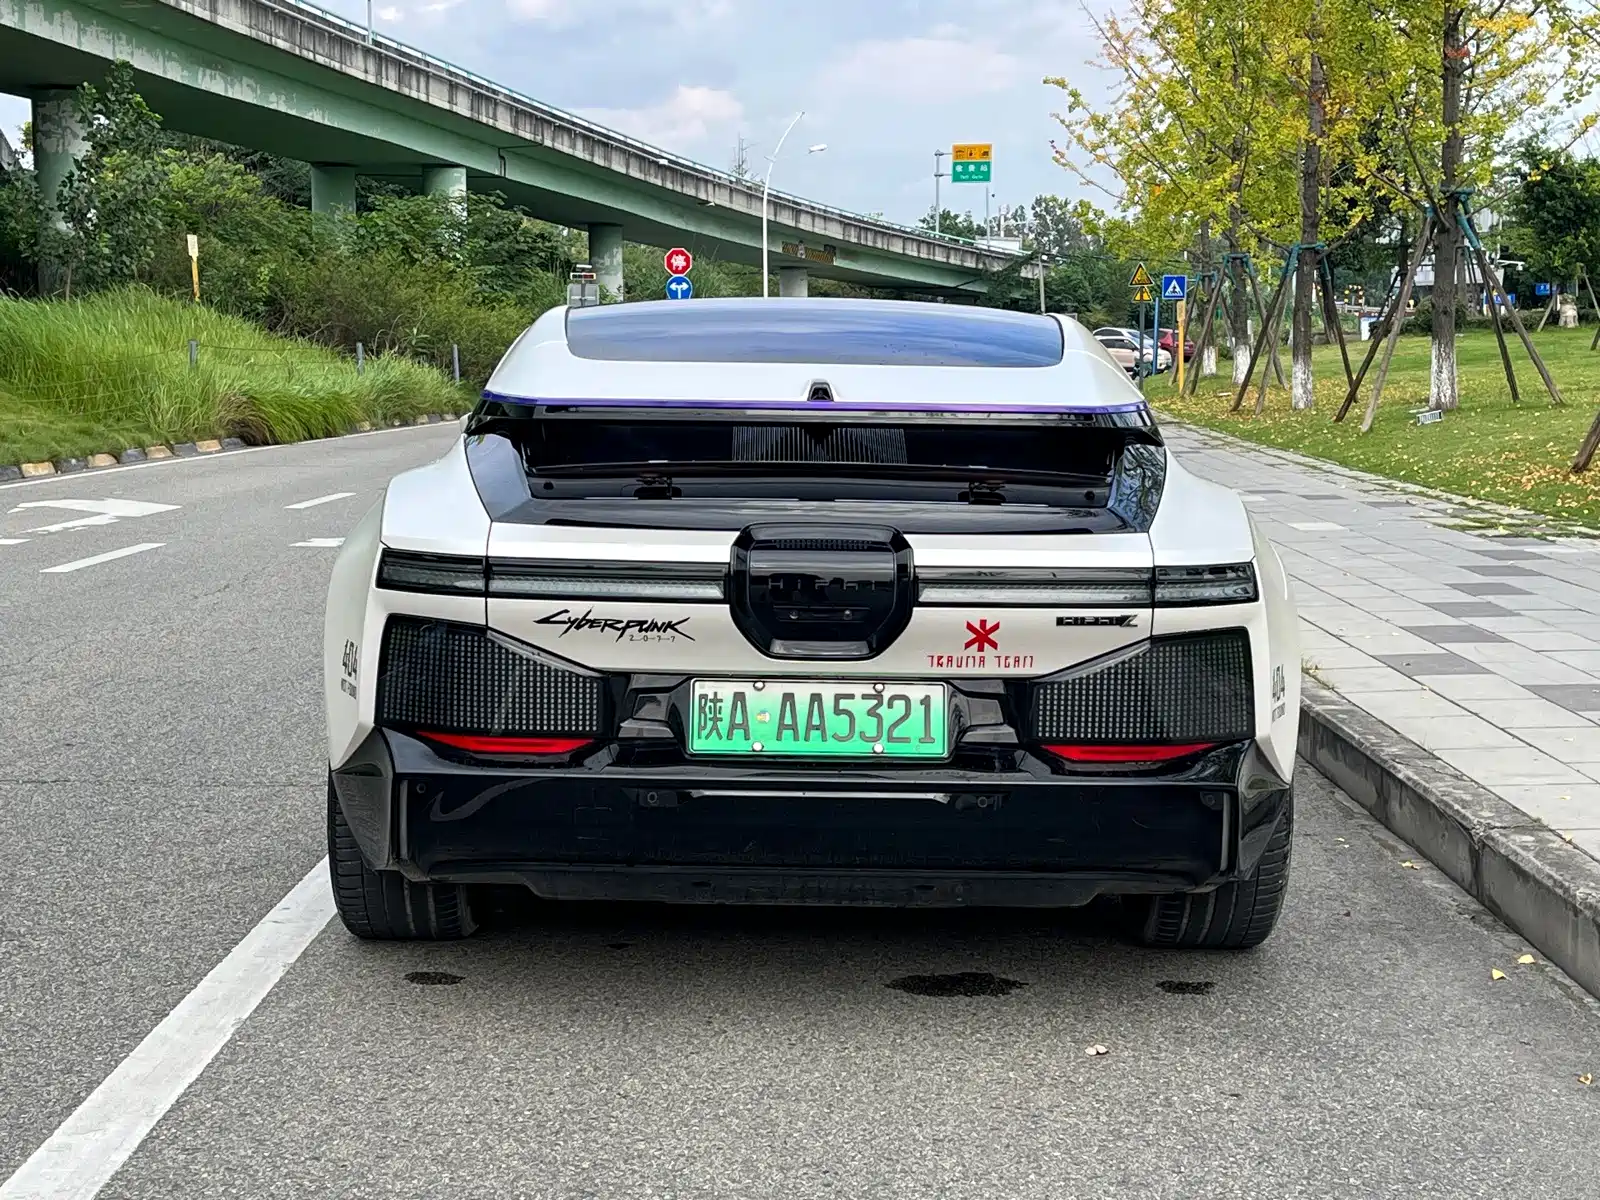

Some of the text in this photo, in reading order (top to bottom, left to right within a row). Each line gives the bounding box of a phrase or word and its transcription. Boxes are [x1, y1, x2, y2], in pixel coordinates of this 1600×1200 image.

[670, 254, 687, 271] 停
[697, 691, 936, 744] 陕A AA5321
